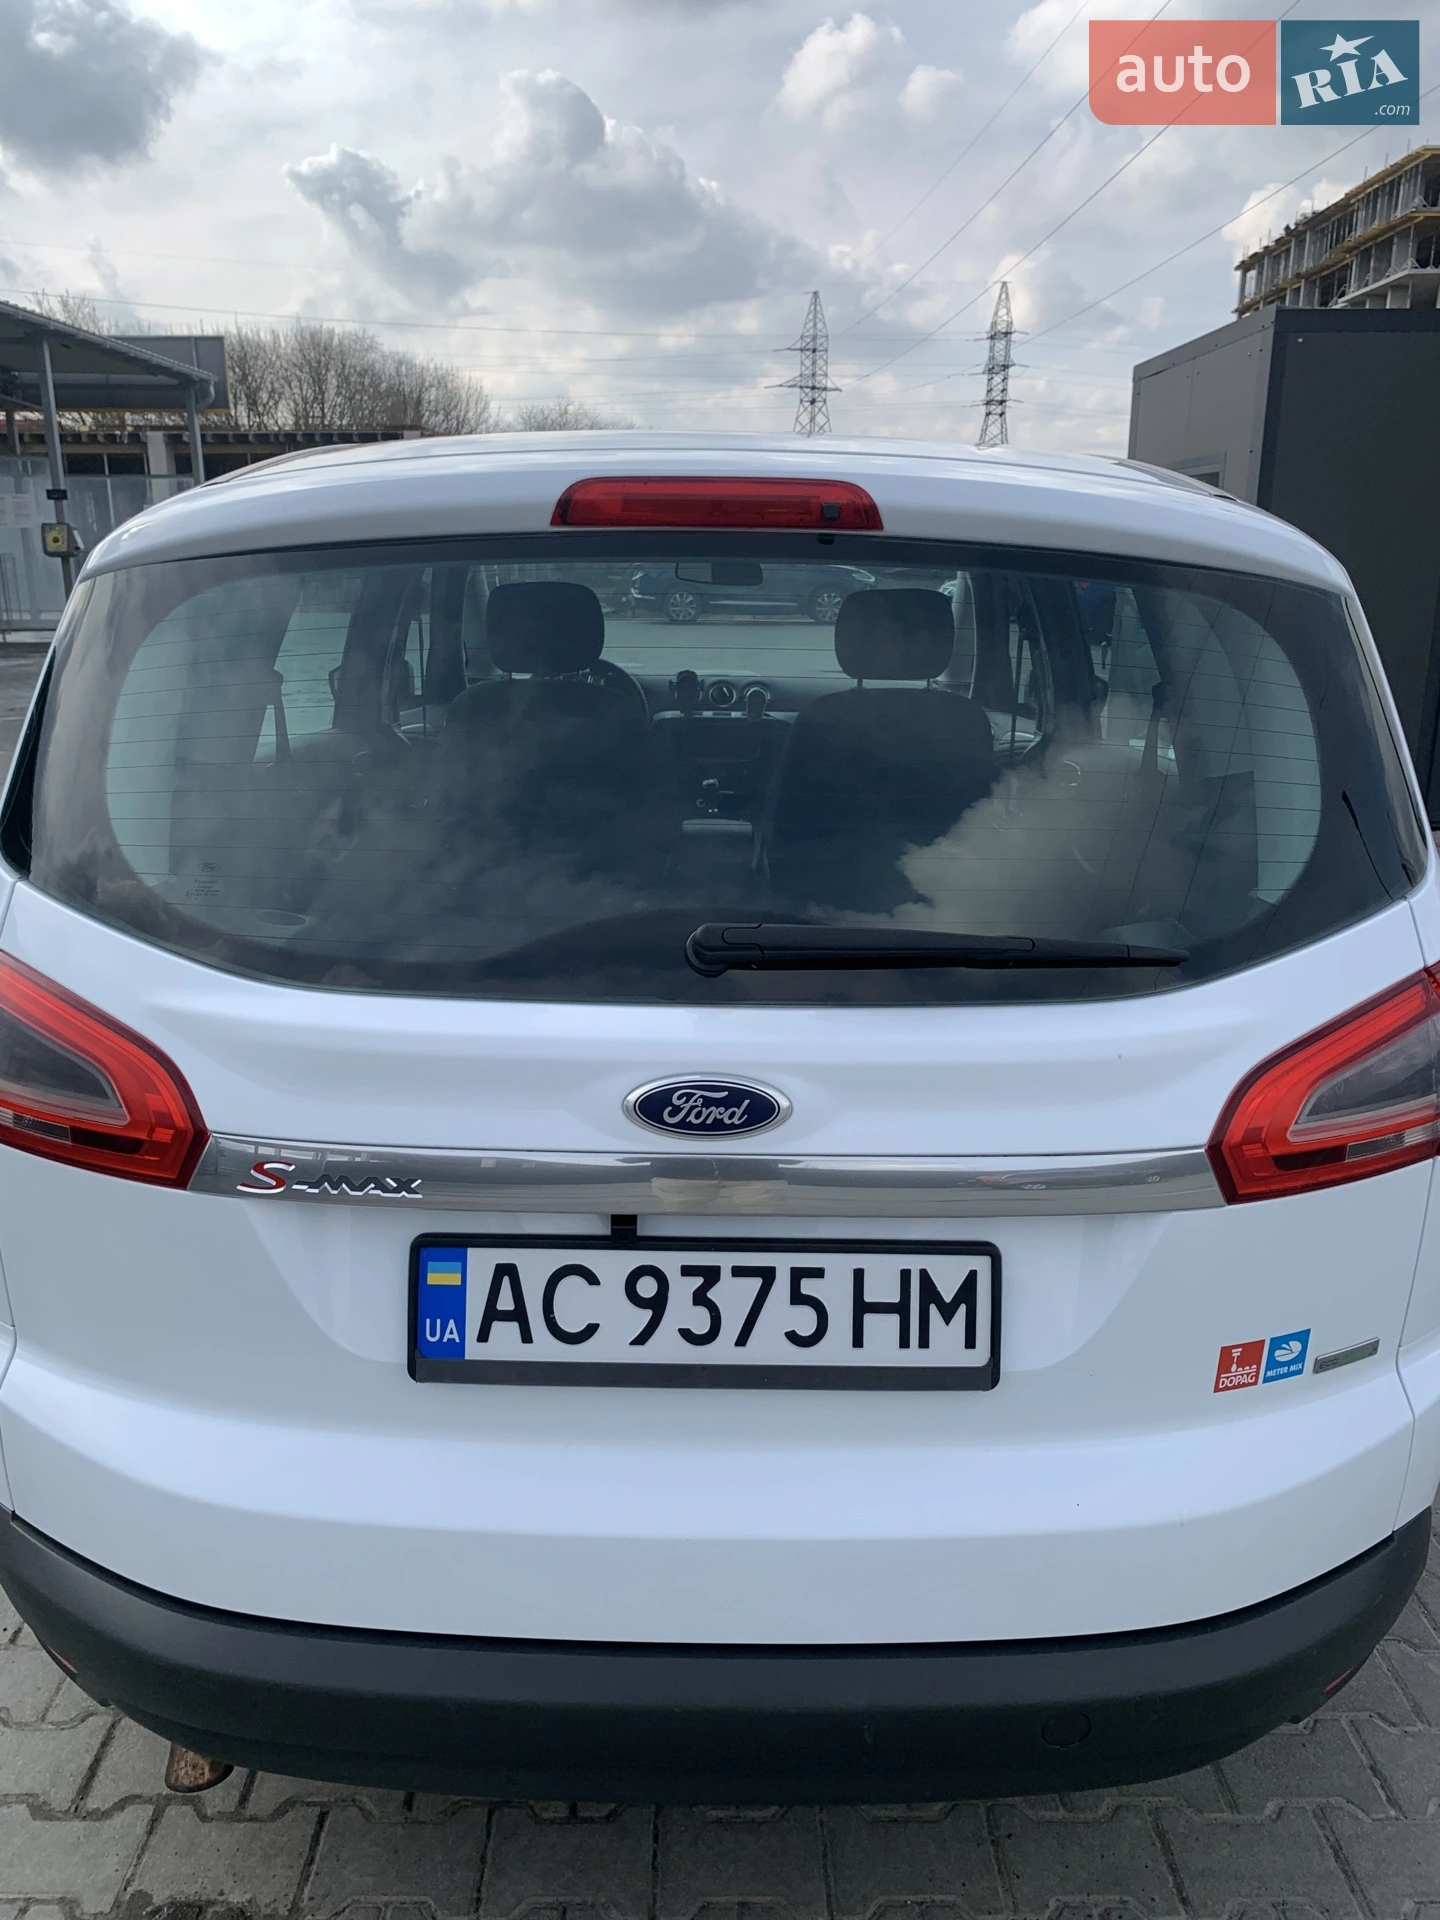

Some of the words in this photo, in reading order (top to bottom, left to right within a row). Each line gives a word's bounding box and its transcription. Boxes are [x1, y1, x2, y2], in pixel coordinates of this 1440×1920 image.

[662, 1089, 750, 1125] Ford
[236, 1160, 424, 1199] S-MAX
[476, 1262, 601, 1346] AC
[624, 1264, 829, 1349] 9375
[851, 1267, 977, 1350] HM
[425, 1317, 461, 1344] UA
[1218, 1372, 1257, 1389] DOPAG
[1265, 1367, 1289, 1378] METER
[1288, 1362, 1304, 1372] MIX
